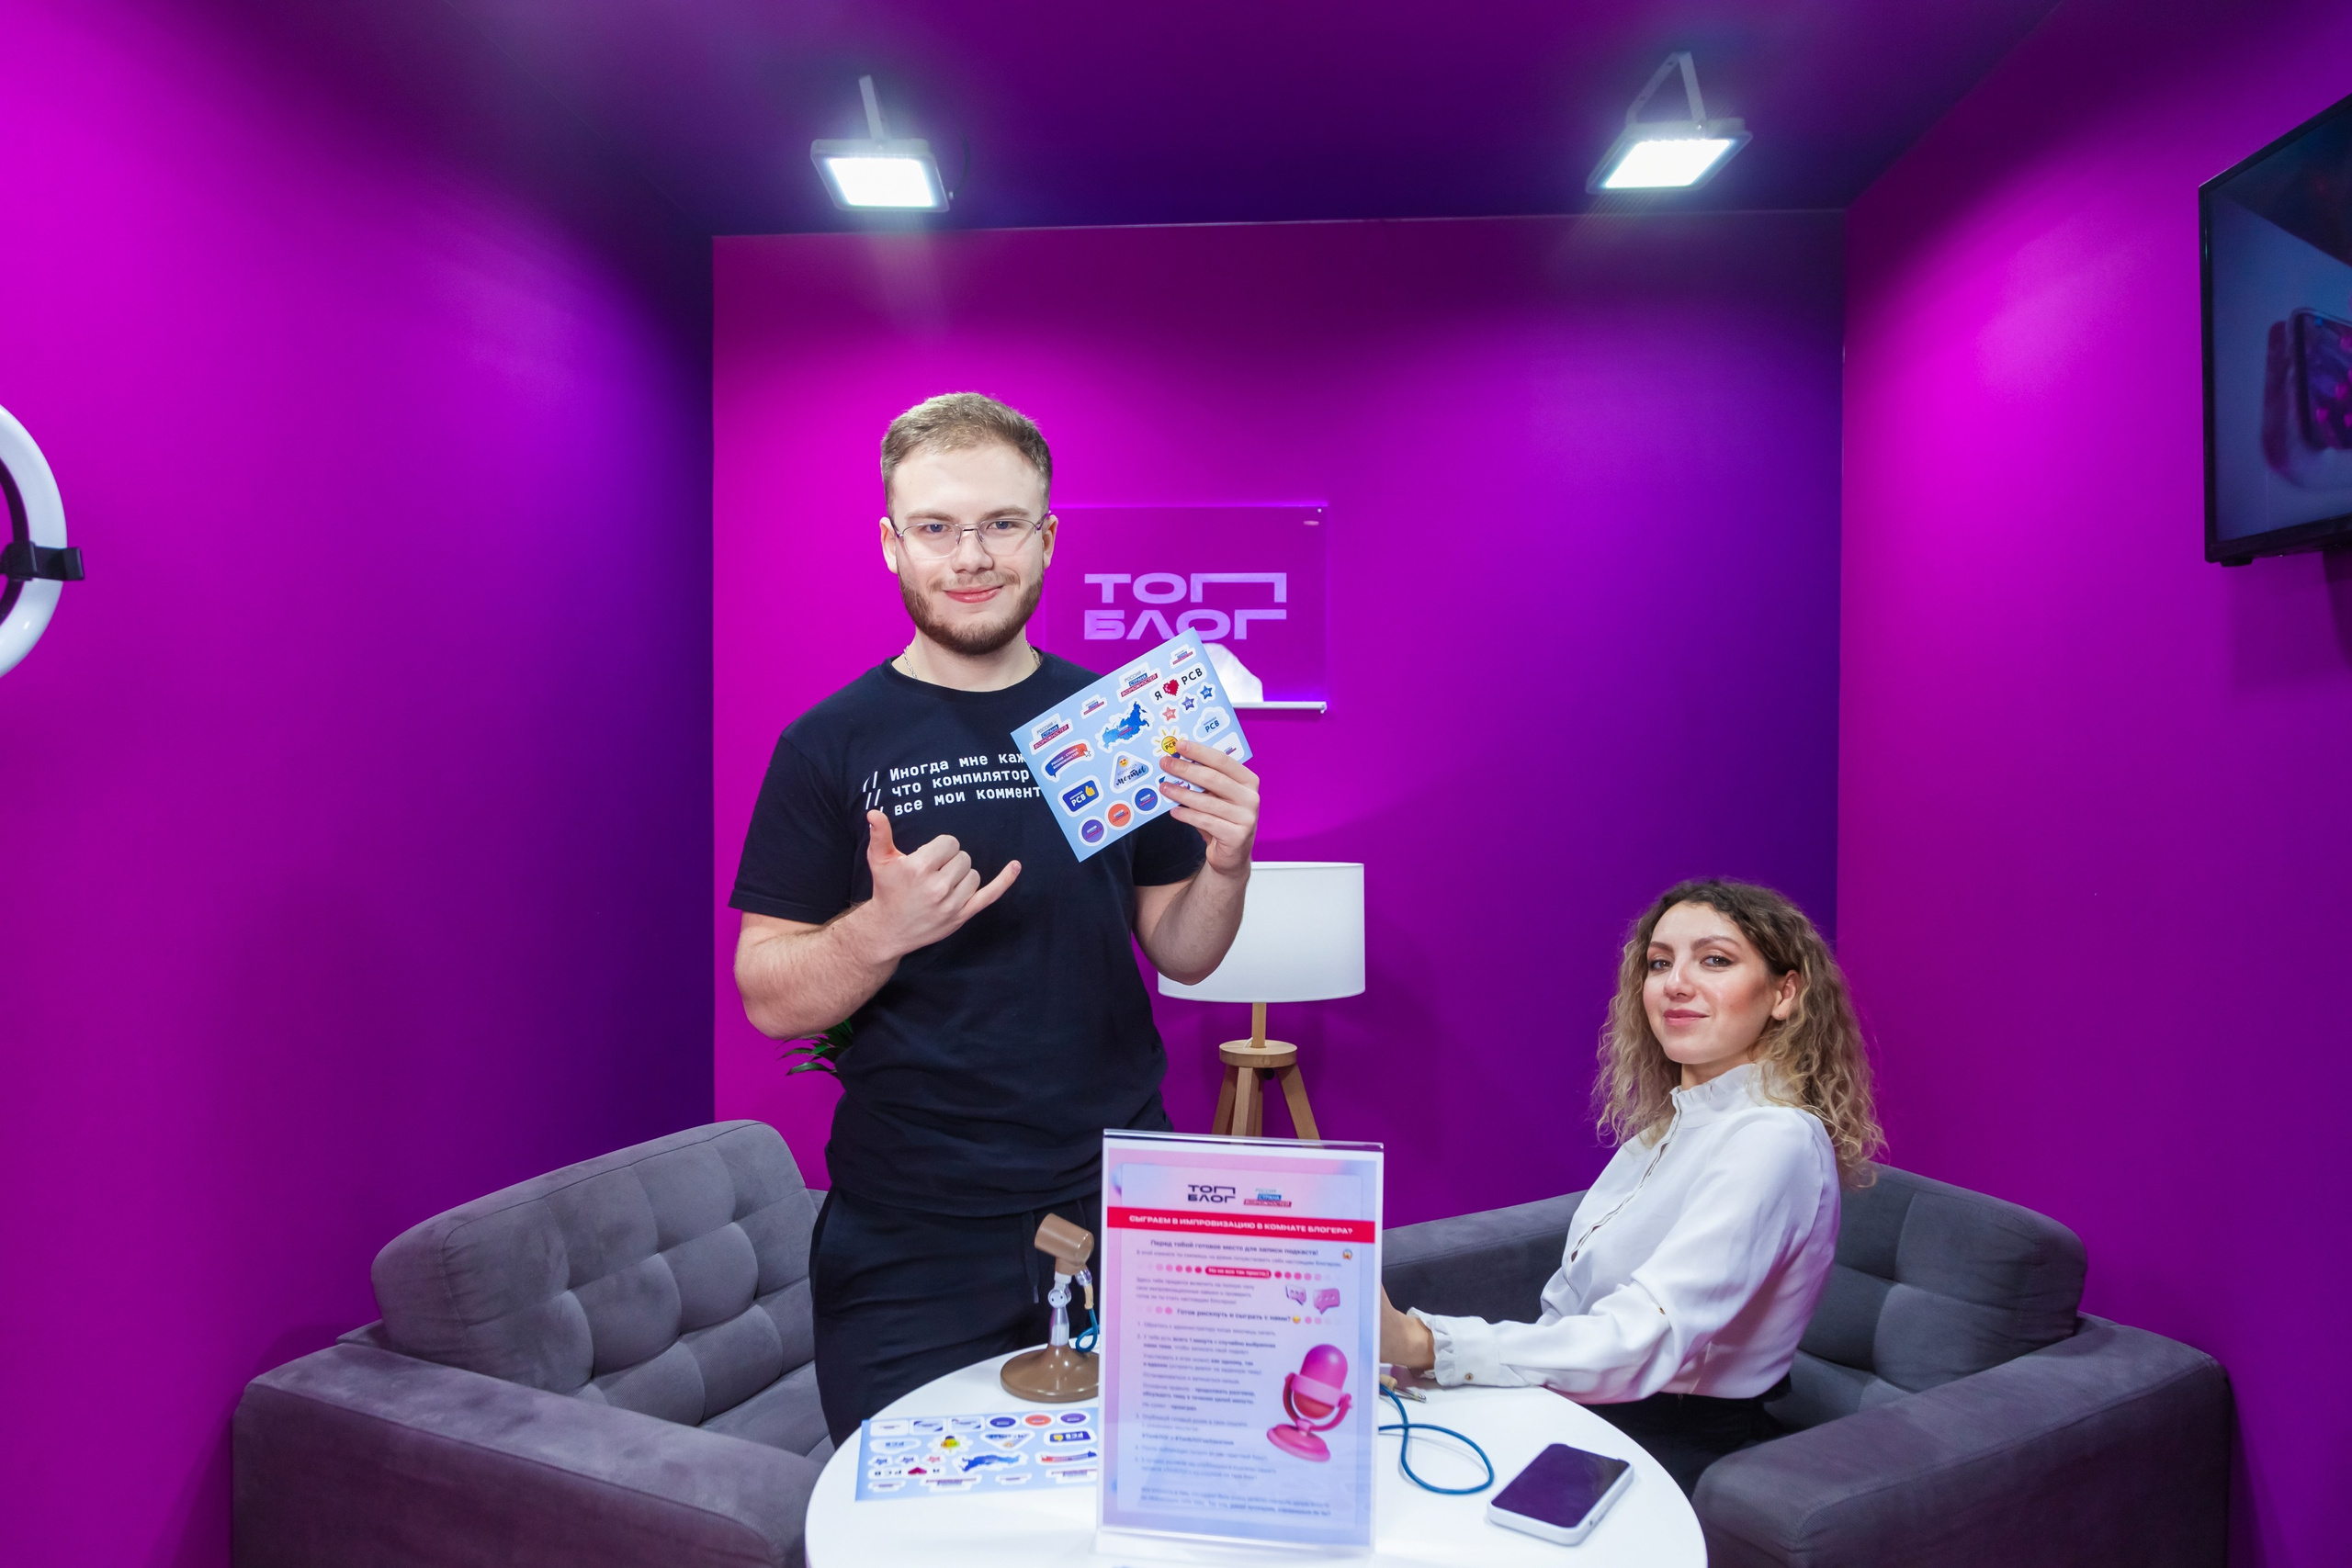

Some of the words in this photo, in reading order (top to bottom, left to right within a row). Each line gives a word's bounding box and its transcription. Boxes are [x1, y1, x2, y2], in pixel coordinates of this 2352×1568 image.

[1084, 572, 1286, 604] ТОП
[1084, 608, 1286, 641] БЛОГ
[1154, 691, 1162, 700] Я
[1182, 668, 1203, 685] РСВ
[1205, 720, 1220, 732] РСВ
[889, 761, 949, 781] Иногда
[959, 755, 989, 767] мне
[999, 752, 1027, 764] каж
[892, 783, 922, 797] что
[933, 769, 1030, 788] компилятор
[895, 799, 923, 816] все
[934, 792, 965, 806] мои
[977, 786, 1041, 800] коммент
[1071, 794, 1086, 807] РСВ
[1188, 1185, 1235, 1194] ТОП
[1188, 1194, 1235, 1203] БЛОГ
[1129, 1215, 1170, 1224] СЫГРАЕМ
[1180, 1218, 1255, 1229] ИМПРОВИЗАЦИЮ
[1264, 1224, 1306, 1232] КОМНАТЕ
[1307, 1226, 1353, 1235] БЛОГЕРА?
